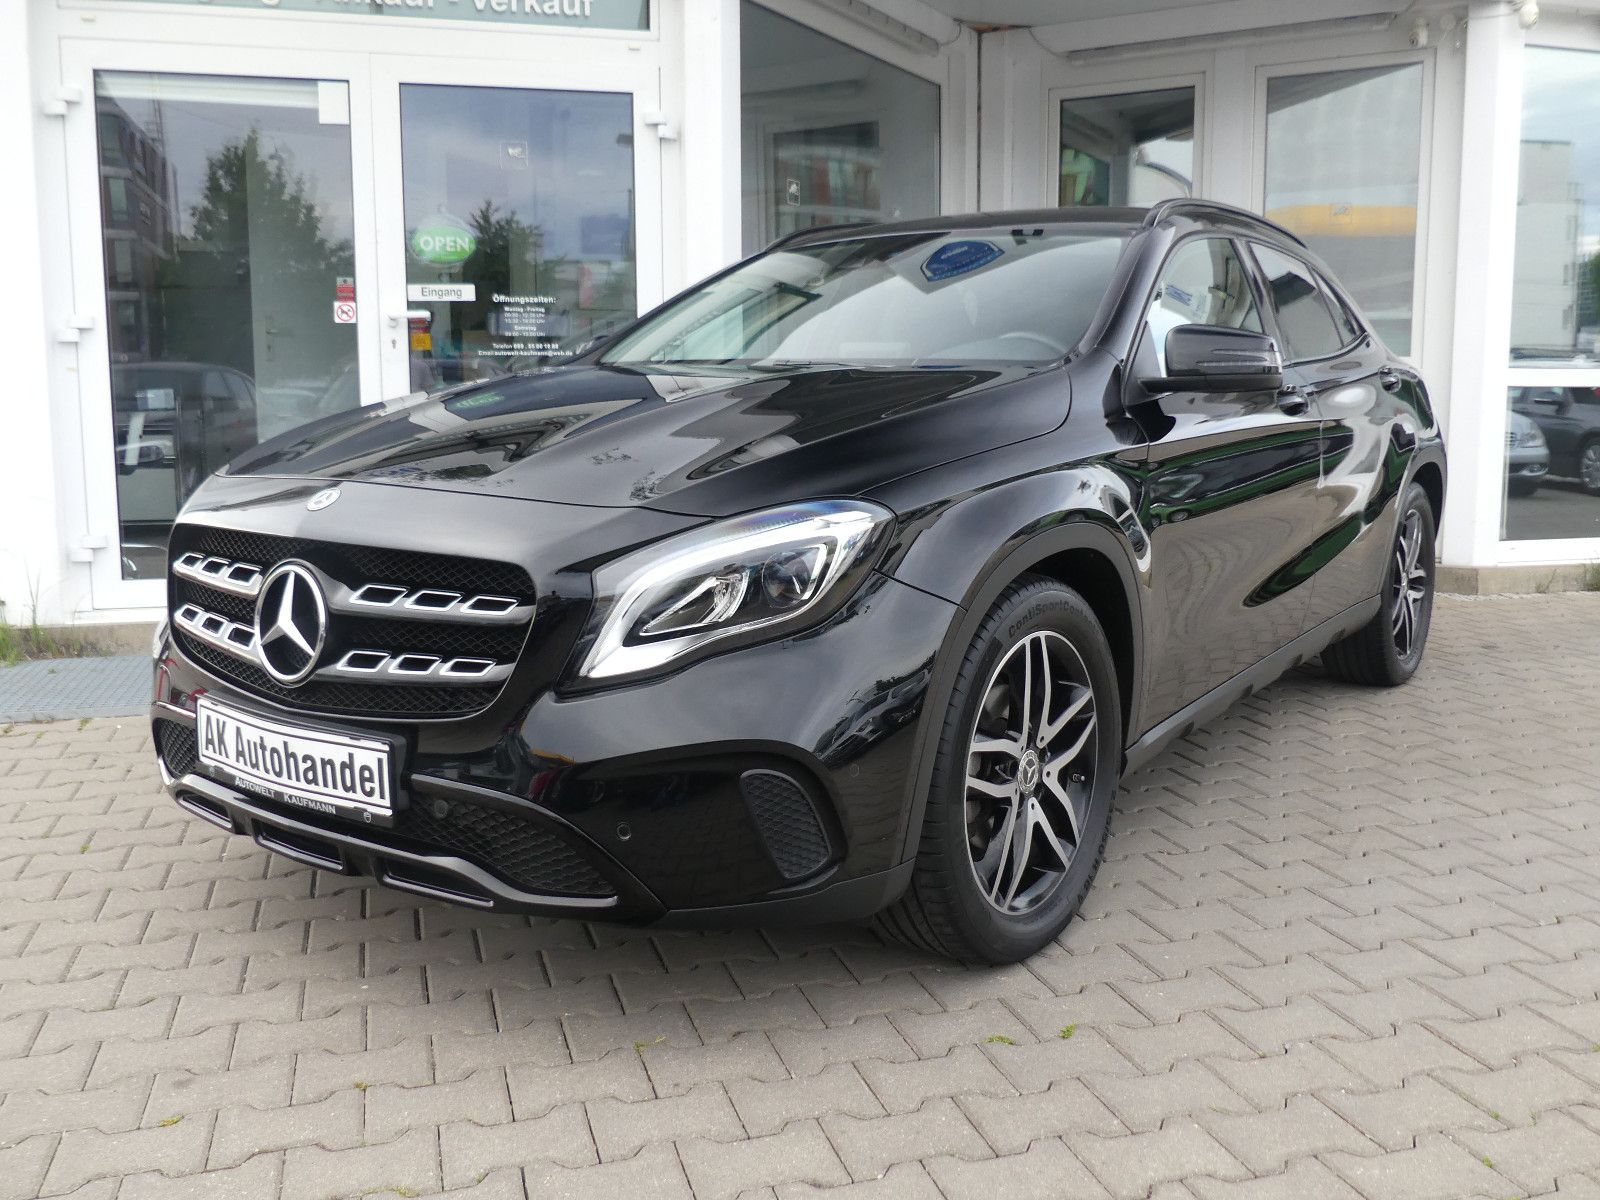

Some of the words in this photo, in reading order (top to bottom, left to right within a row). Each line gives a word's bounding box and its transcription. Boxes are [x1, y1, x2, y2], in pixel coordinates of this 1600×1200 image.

[419, 236, 470, 252] OPEN
[421, 287, 462, 299] Eingang
[205, 714, 230, 759] AK
[235, 725, 387, 800] Autohandel
[235, 776, 276, 798] AUTOWELT
[283, 793, 337, 814] KAUFMANN
